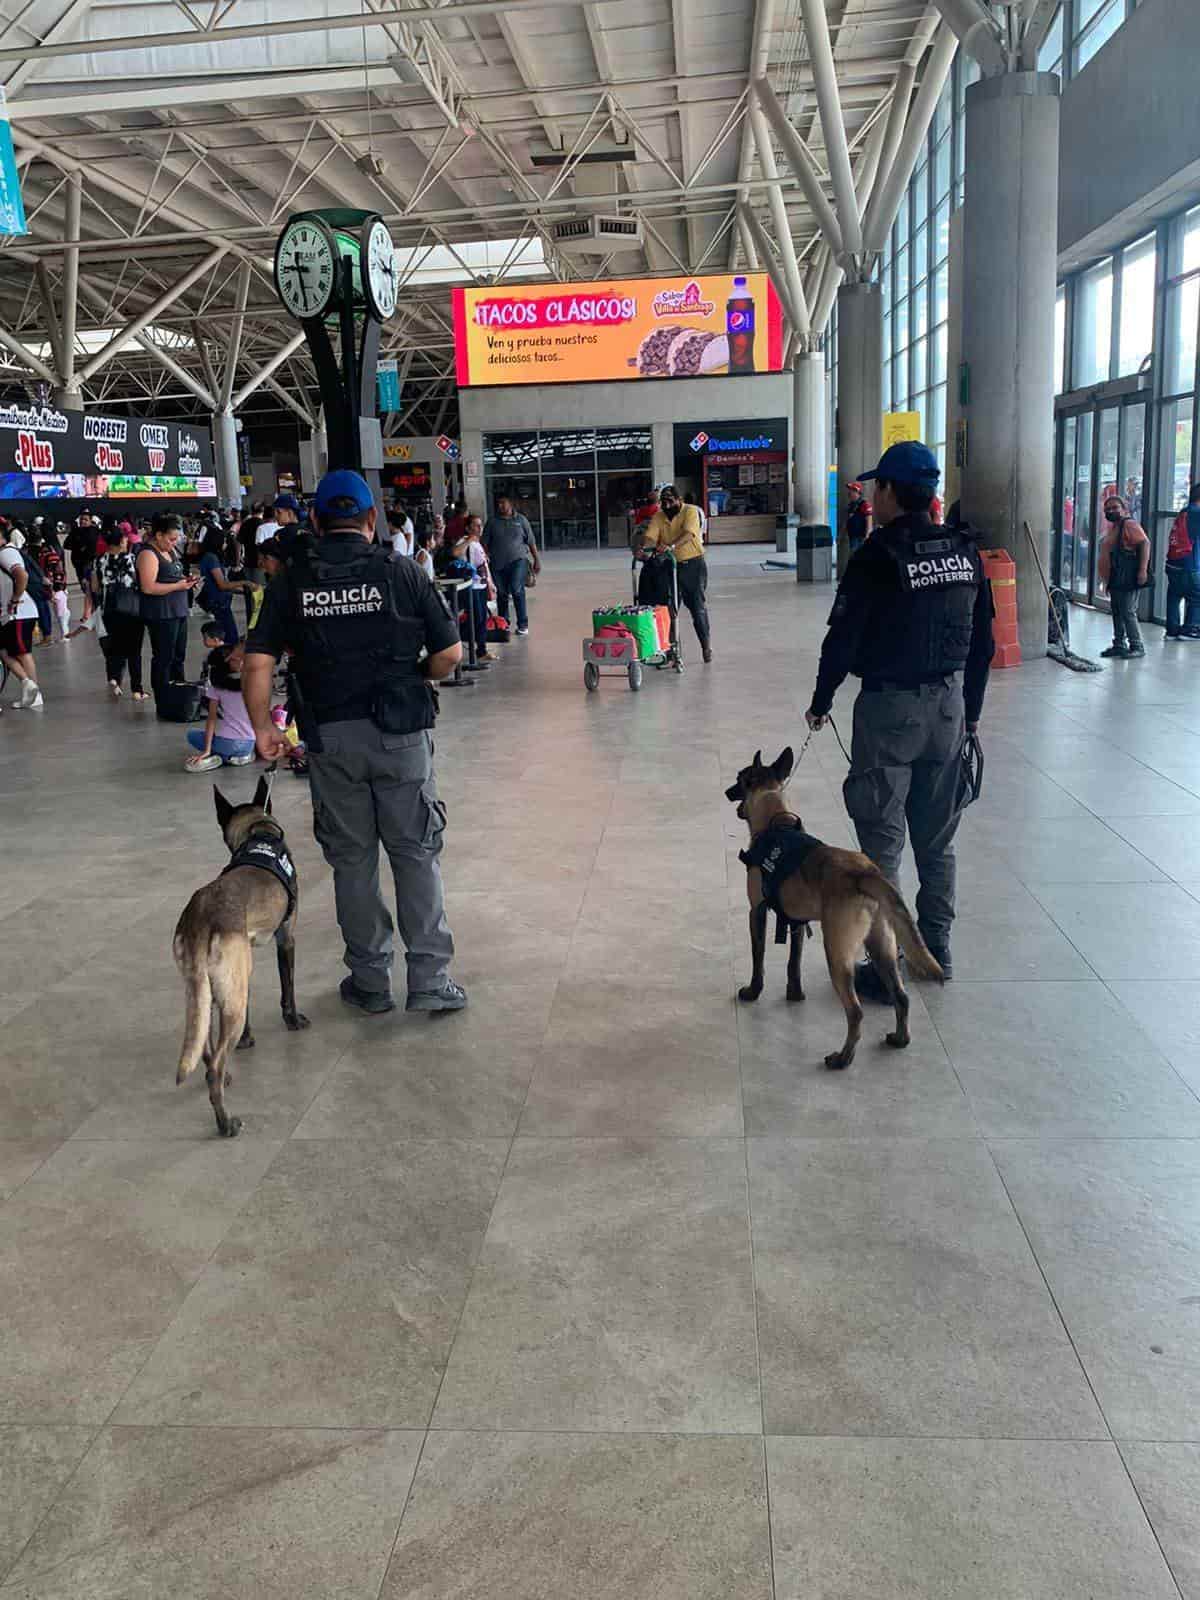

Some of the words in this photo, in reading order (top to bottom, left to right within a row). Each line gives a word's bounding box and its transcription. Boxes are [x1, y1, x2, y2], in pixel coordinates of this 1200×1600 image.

[487, 335, 505, 349] Ven
[507, 340, 514, 350] y
[516, 336, 552, 350] prueba
[555, 334, 598, 345] nuestros
[487, 353, 532, 365] deliciosos
[85, 418, 127, 441] NORESTE
[141, 425, 168, 447] OMEX
[18, 433, 53, 470] Plus
[708, 434, 771, 451] Domino's
[98, 445, 123, 470] Plus
[148, 450, 165, 471] VIP
[907, 554, 974, 577] POLICÍA
[910, 571, 975, 589] MONTERREY
[302, 583, 382, 606] POLICÍA
[303, 601, 383, 617] MONTERREY
